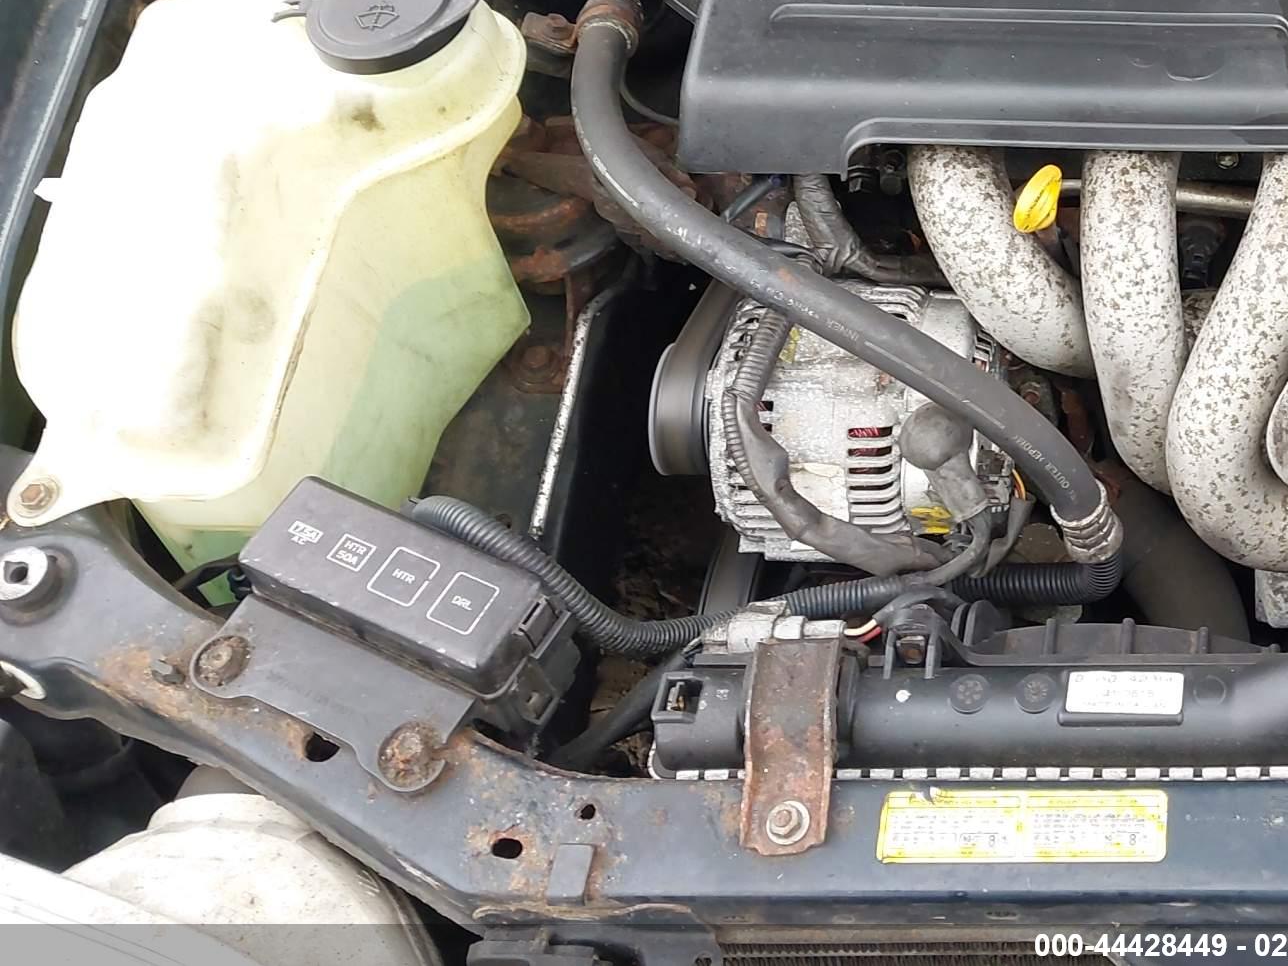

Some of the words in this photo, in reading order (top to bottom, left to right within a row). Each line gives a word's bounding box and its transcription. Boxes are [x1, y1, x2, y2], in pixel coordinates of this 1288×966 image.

[1045, 461, 1070, 489] OUTER
[343, 539, 368, 556] HTR
[336, 550, 360, 566] 50A
[391, 568, 416, 585] HTR
[451, 595, 473, 611] DRL
